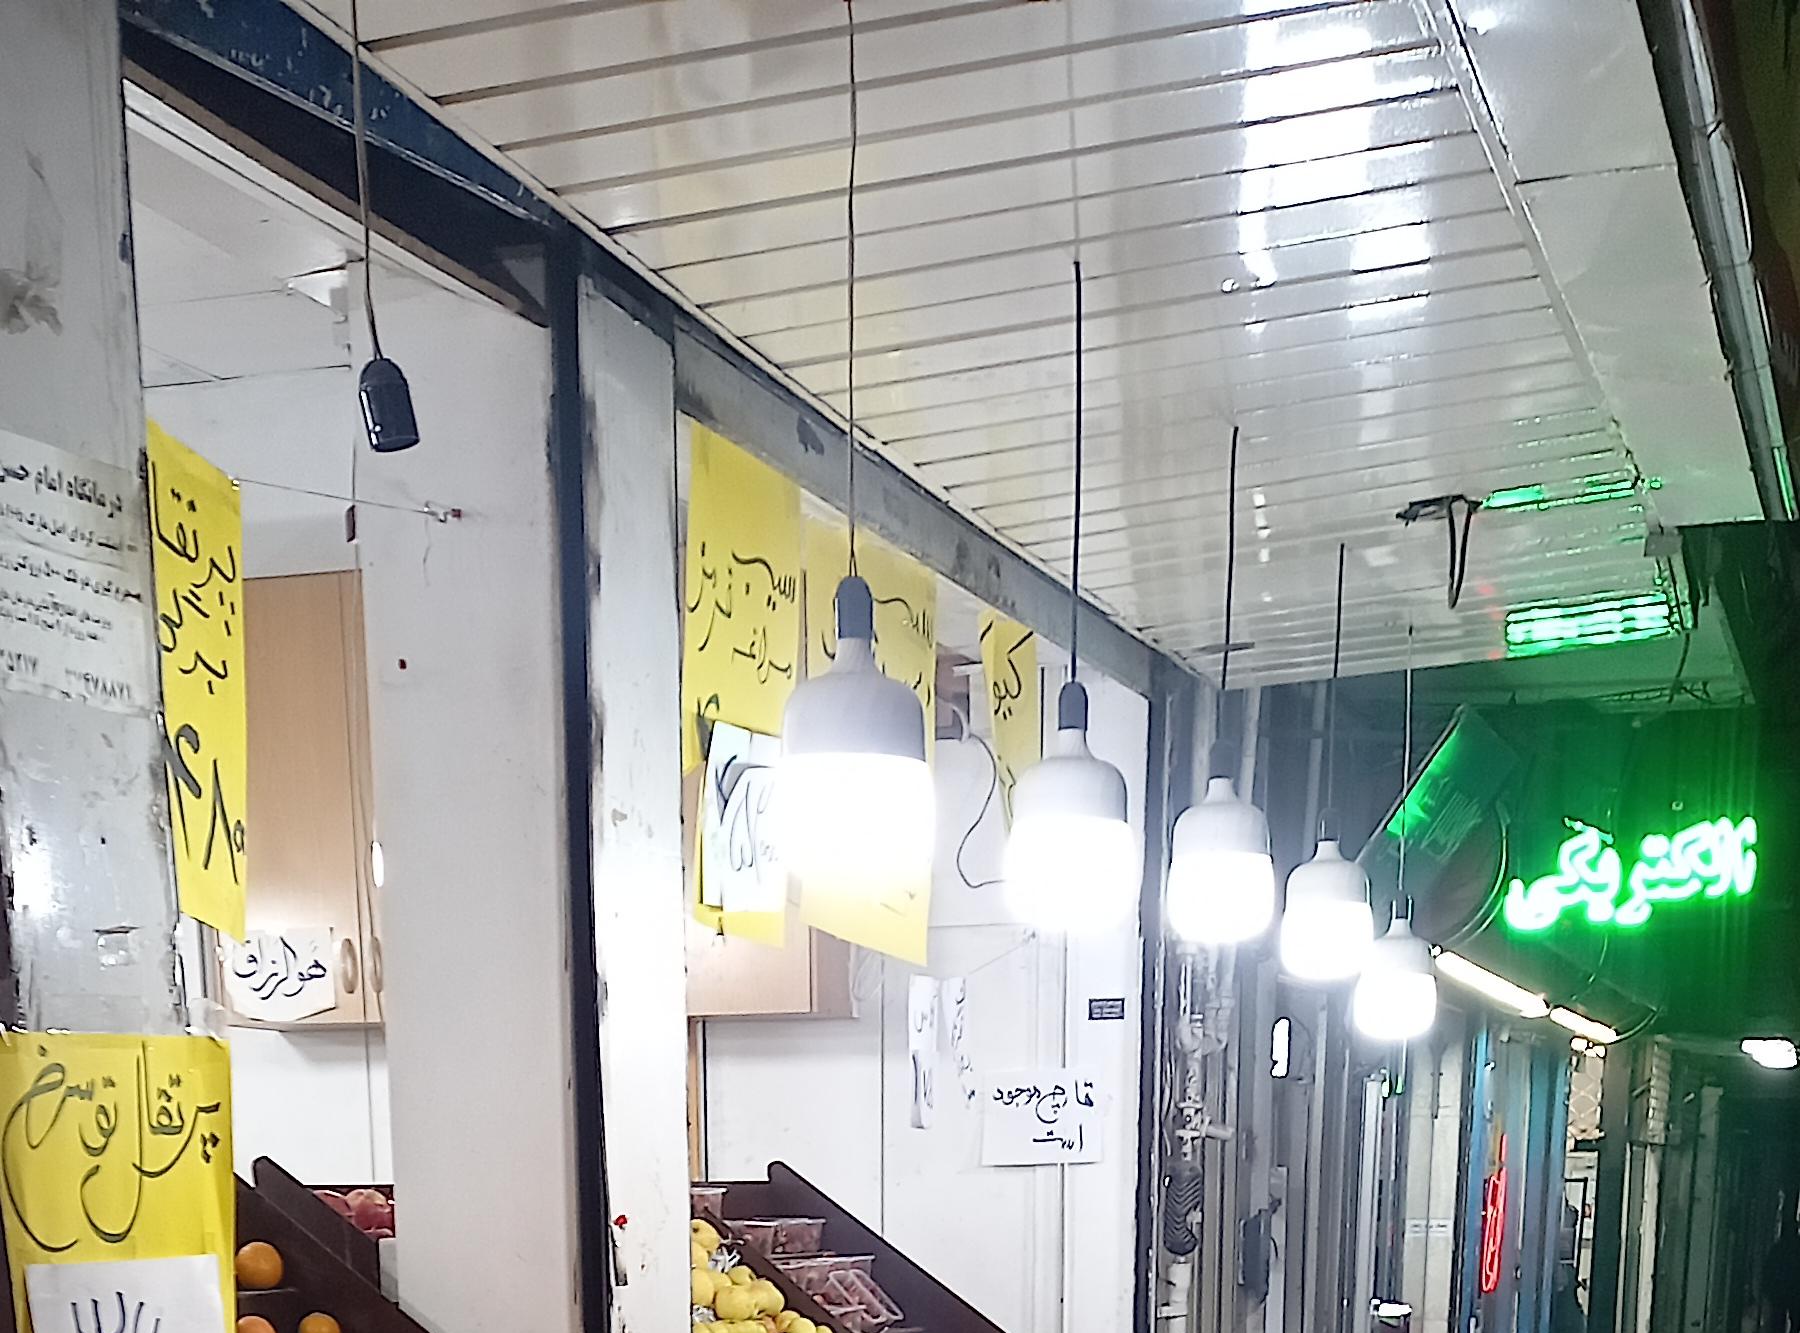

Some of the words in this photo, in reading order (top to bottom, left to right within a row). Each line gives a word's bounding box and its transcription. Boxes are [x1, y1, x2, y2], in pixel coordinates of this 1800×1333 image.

[34, 464, 62, 494] امام
[731, 549, 796, 612] سیب
[992, 1085, 1042, 1108] موجود
[1035, 1080, 1094, 1124] قارچ
[80, 1041, 221, 1244] پرتقال
[1032, 1123, 1083, 1152] است
